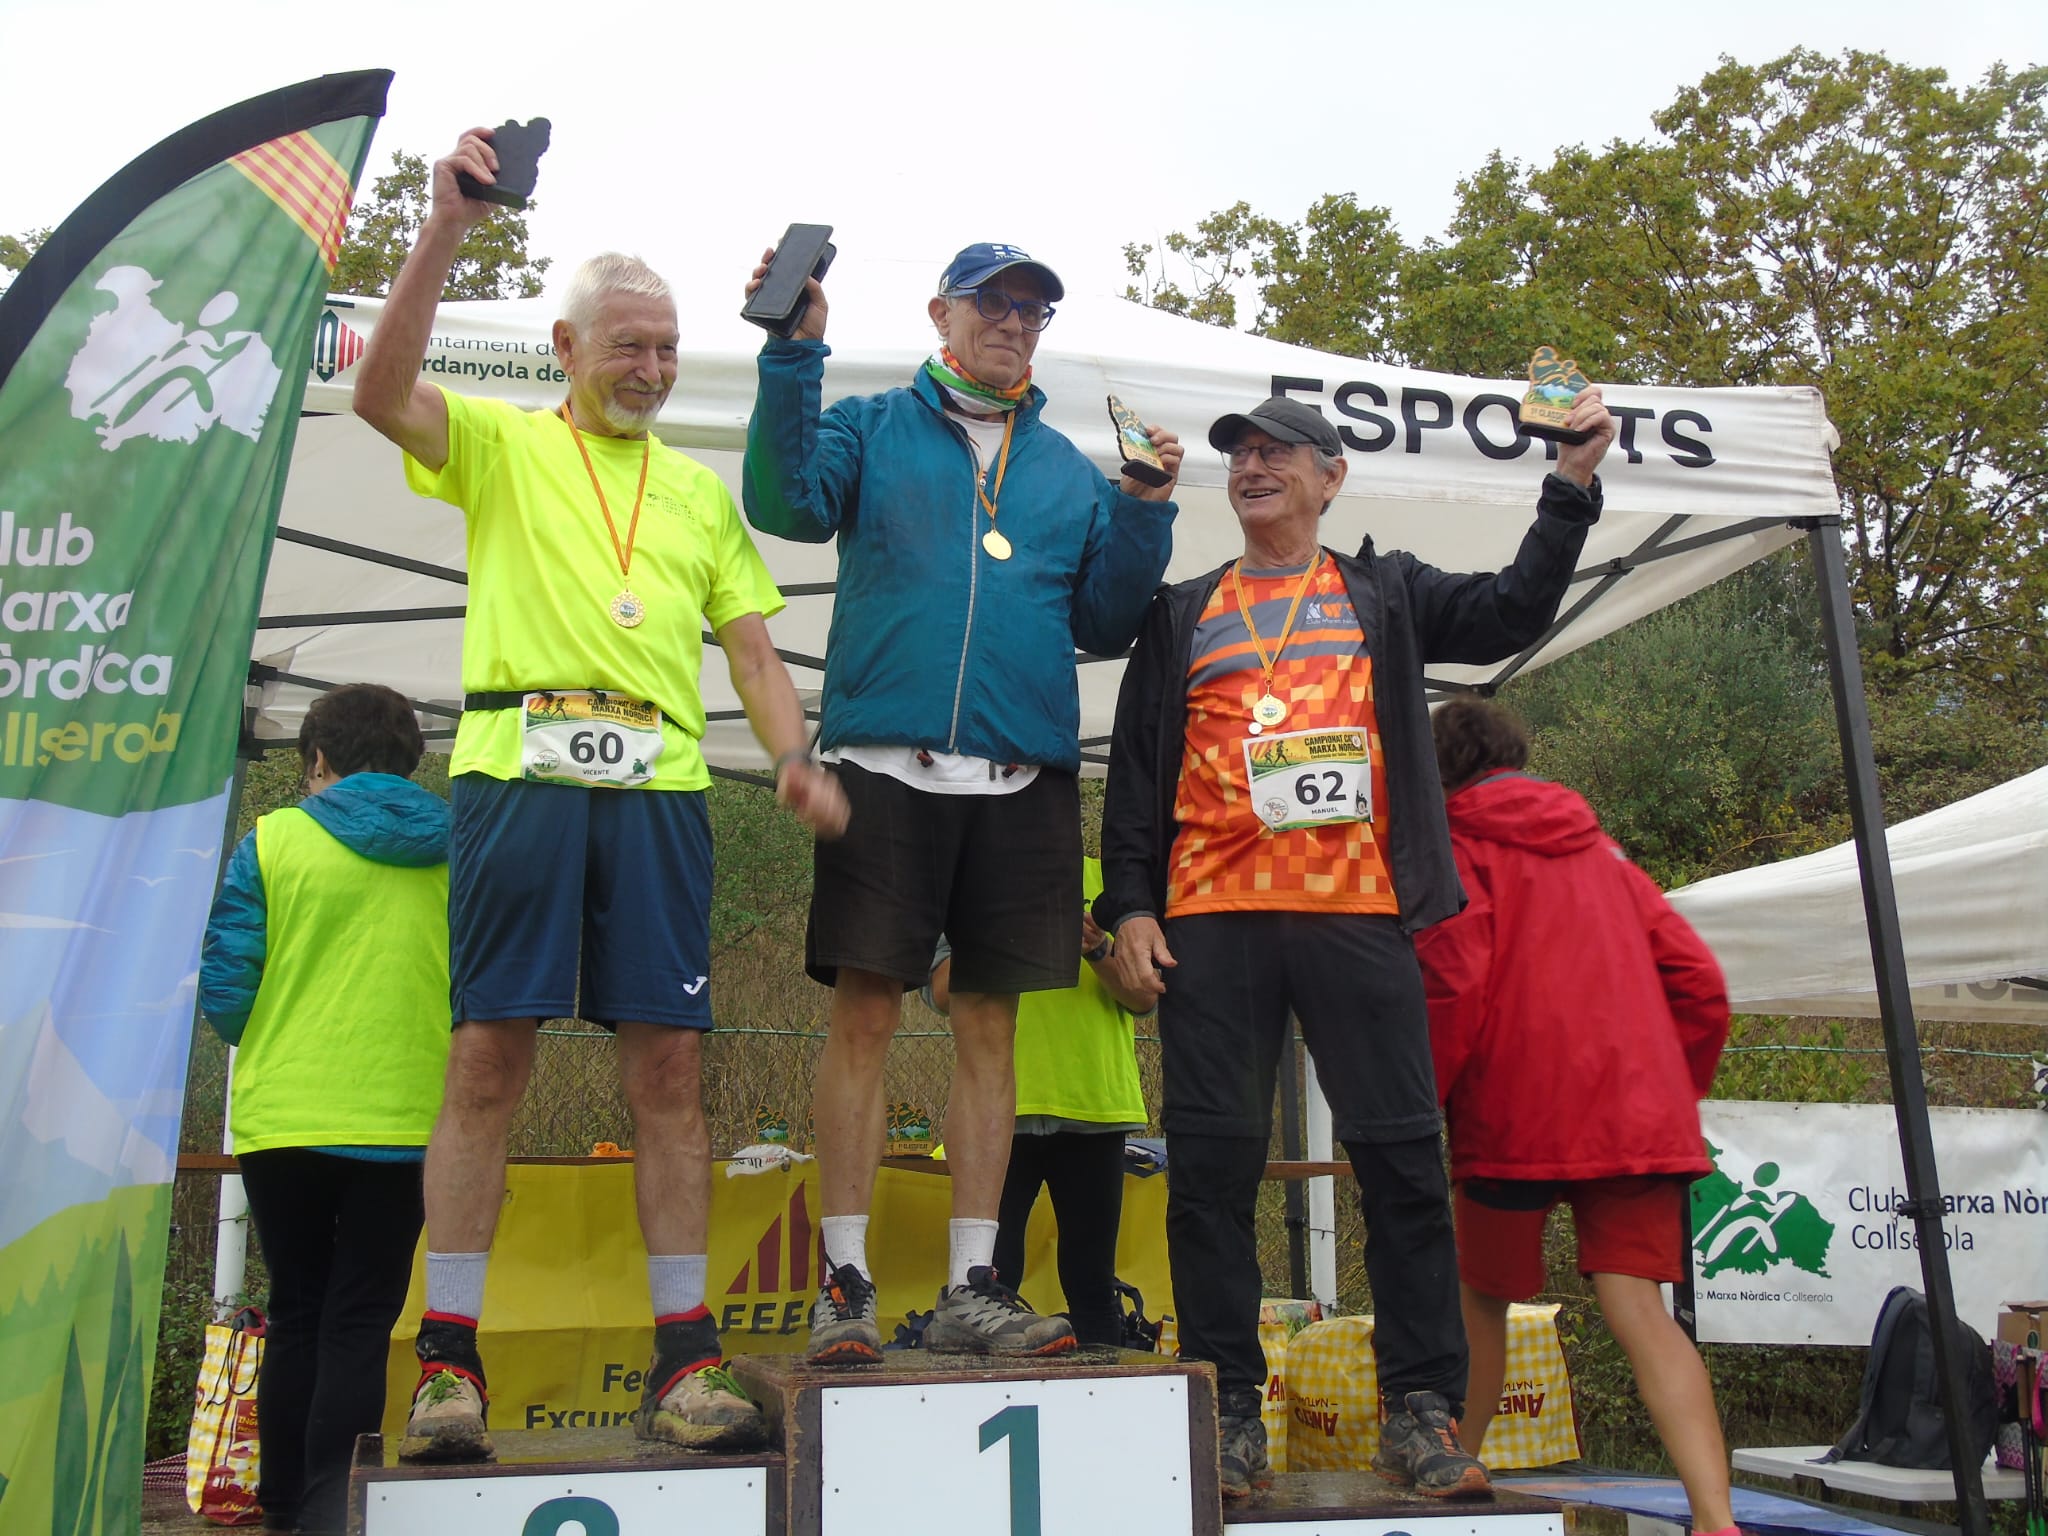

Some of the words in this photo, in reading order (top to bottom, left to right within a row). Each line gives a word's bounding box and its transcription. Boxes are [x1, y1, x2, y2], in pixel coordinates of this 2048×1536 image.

[536, 363, 571, 382] de
[1271, 375, 1717, 469] ESPOTS
[0, 578, 135, 633] arxa
[569, 731, 624, 764] 60
[1309, 743, 1337, 754] MARXA
[1295, 770, 1347, 805] 62
[1311, 807, 1339, 815] MANUEL
[1852, 1223, 1974, 1251] Collseola
[1706, 1290, 1737, 1301] Marxa
[1740, 1289, 1781, 1302] Nòrdica
[1783, 1291, 1833, 1303] Collserola
[602, 1363, 650, 1393] Fe
[978, 1404, 1042, 1536] 1
